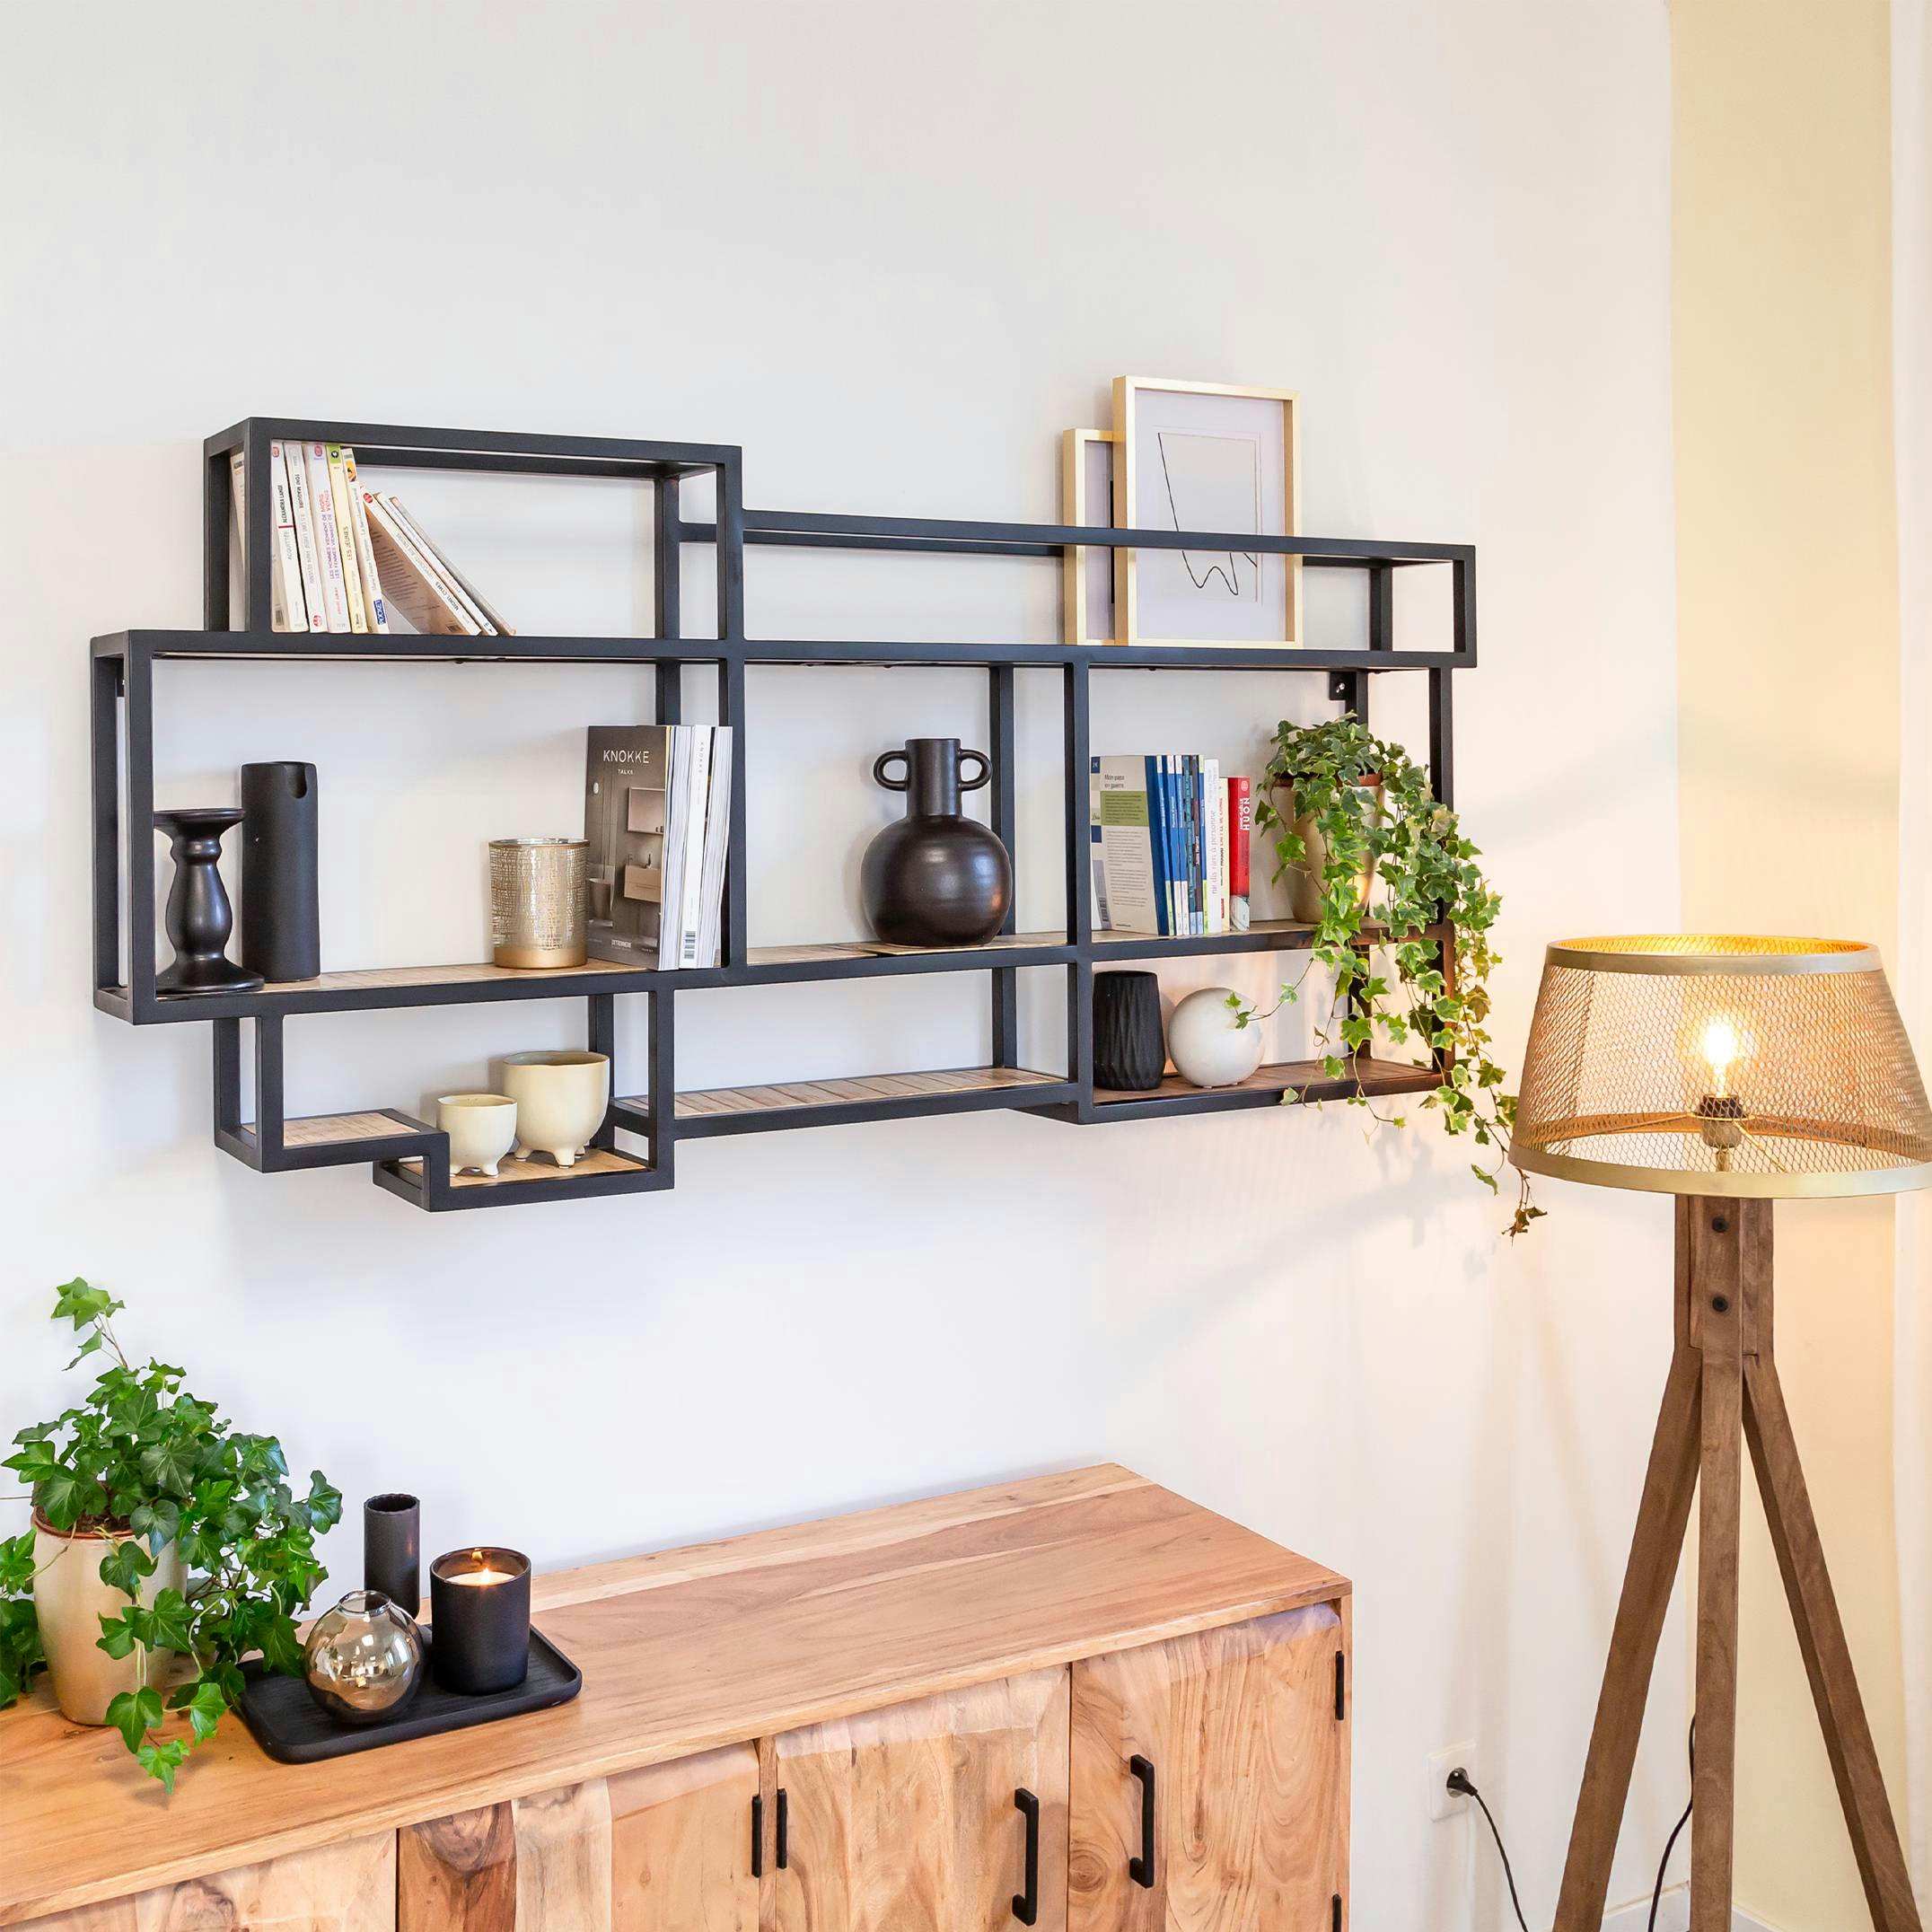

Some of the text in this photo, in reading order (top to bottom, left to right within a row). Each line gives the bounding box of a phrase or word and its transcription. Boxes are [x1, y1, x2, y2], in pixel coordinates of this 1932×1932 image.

[296, 486, 304, 508] MAGUIRE
[342, 525, 351, 548] JEUNES
[374, 599, 385, 625] POCKET
[603, 750, 649, 763] KNOKKE
[1209, 811, 1217, 845] personne
